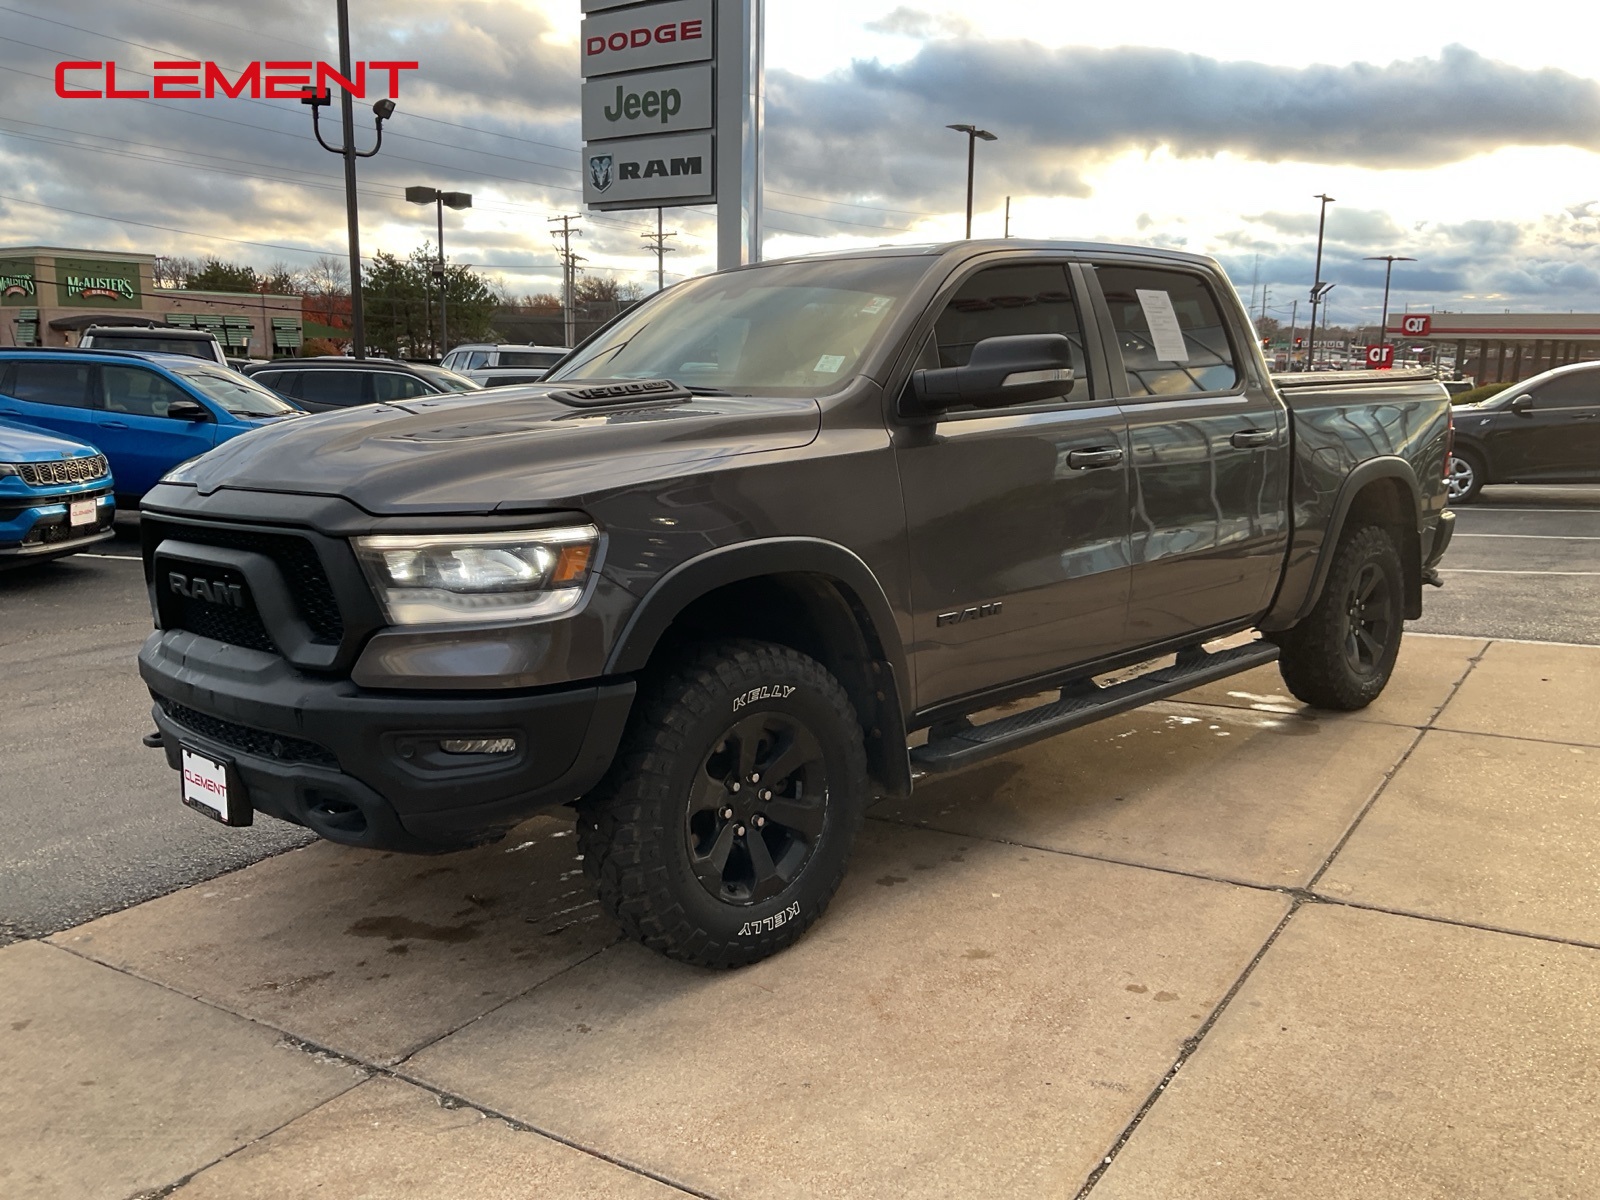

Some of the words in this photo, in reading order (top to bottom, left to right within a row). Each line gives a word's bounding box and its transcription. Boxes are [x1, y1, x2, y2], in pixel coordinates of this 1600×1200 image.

[587, 20, 702, 56] DODGE
[604, 85, 681, 123] Jeep
[619, 156, 702, 180] RAM
[1405, 318, 1426, 333] QT
[1369, 348, 1389, 362] QT
[169, 572, 245, 608] RAM
[937, 602, 1002, 627] RAM
[733, 685, 796, 712] KELLY
[185, 769, 227, 797] CLEMENT
[738, 901, 800, 935] KELLY
